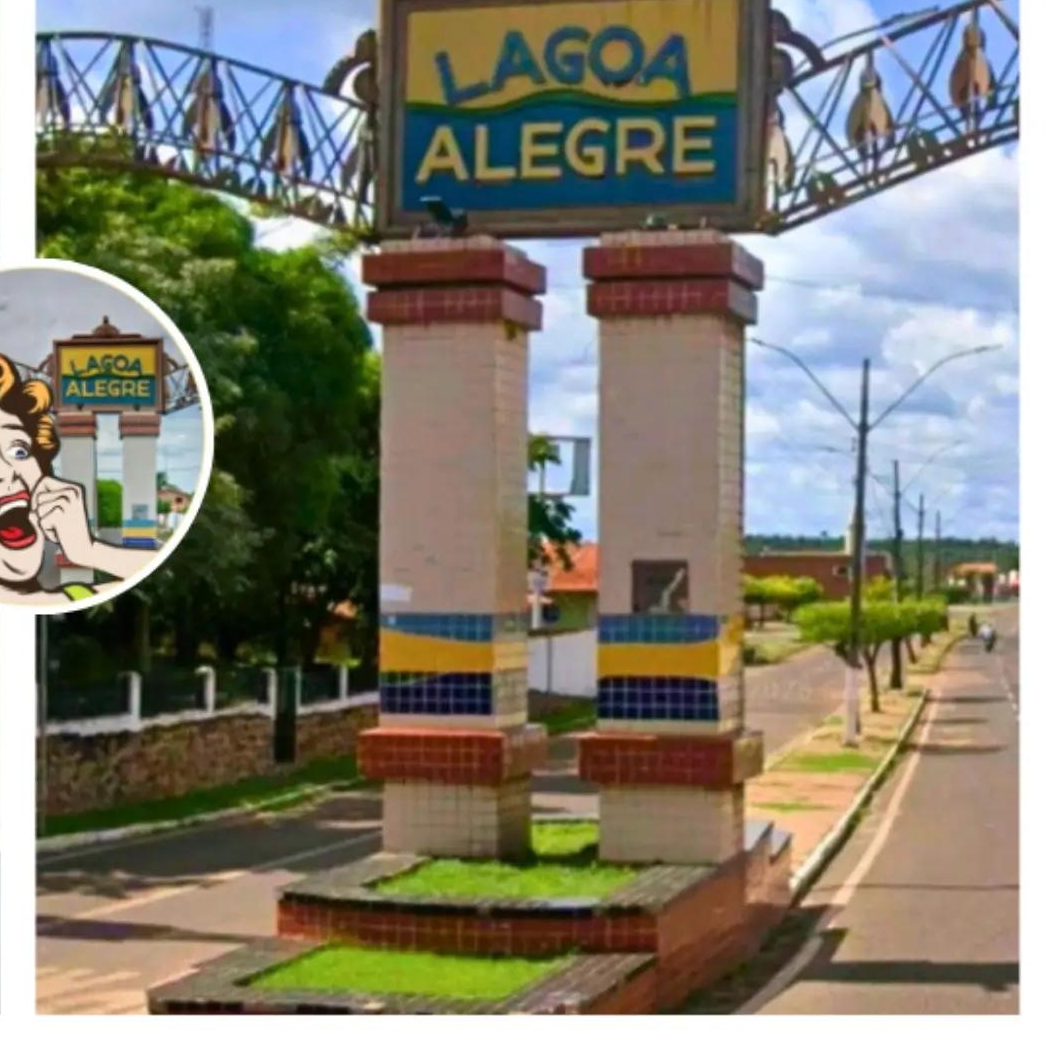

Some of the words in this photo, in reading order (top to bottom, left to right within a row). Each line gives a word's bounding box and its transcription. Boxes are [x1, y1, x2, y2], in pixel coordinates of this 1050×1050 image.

[434, 24, 692, 107] LAGOA
[415, 115, 718, 184] ALEGRE
[65, 379, 151, 398] ALEGRE
[69, 354, 143, 377] LAGOA
